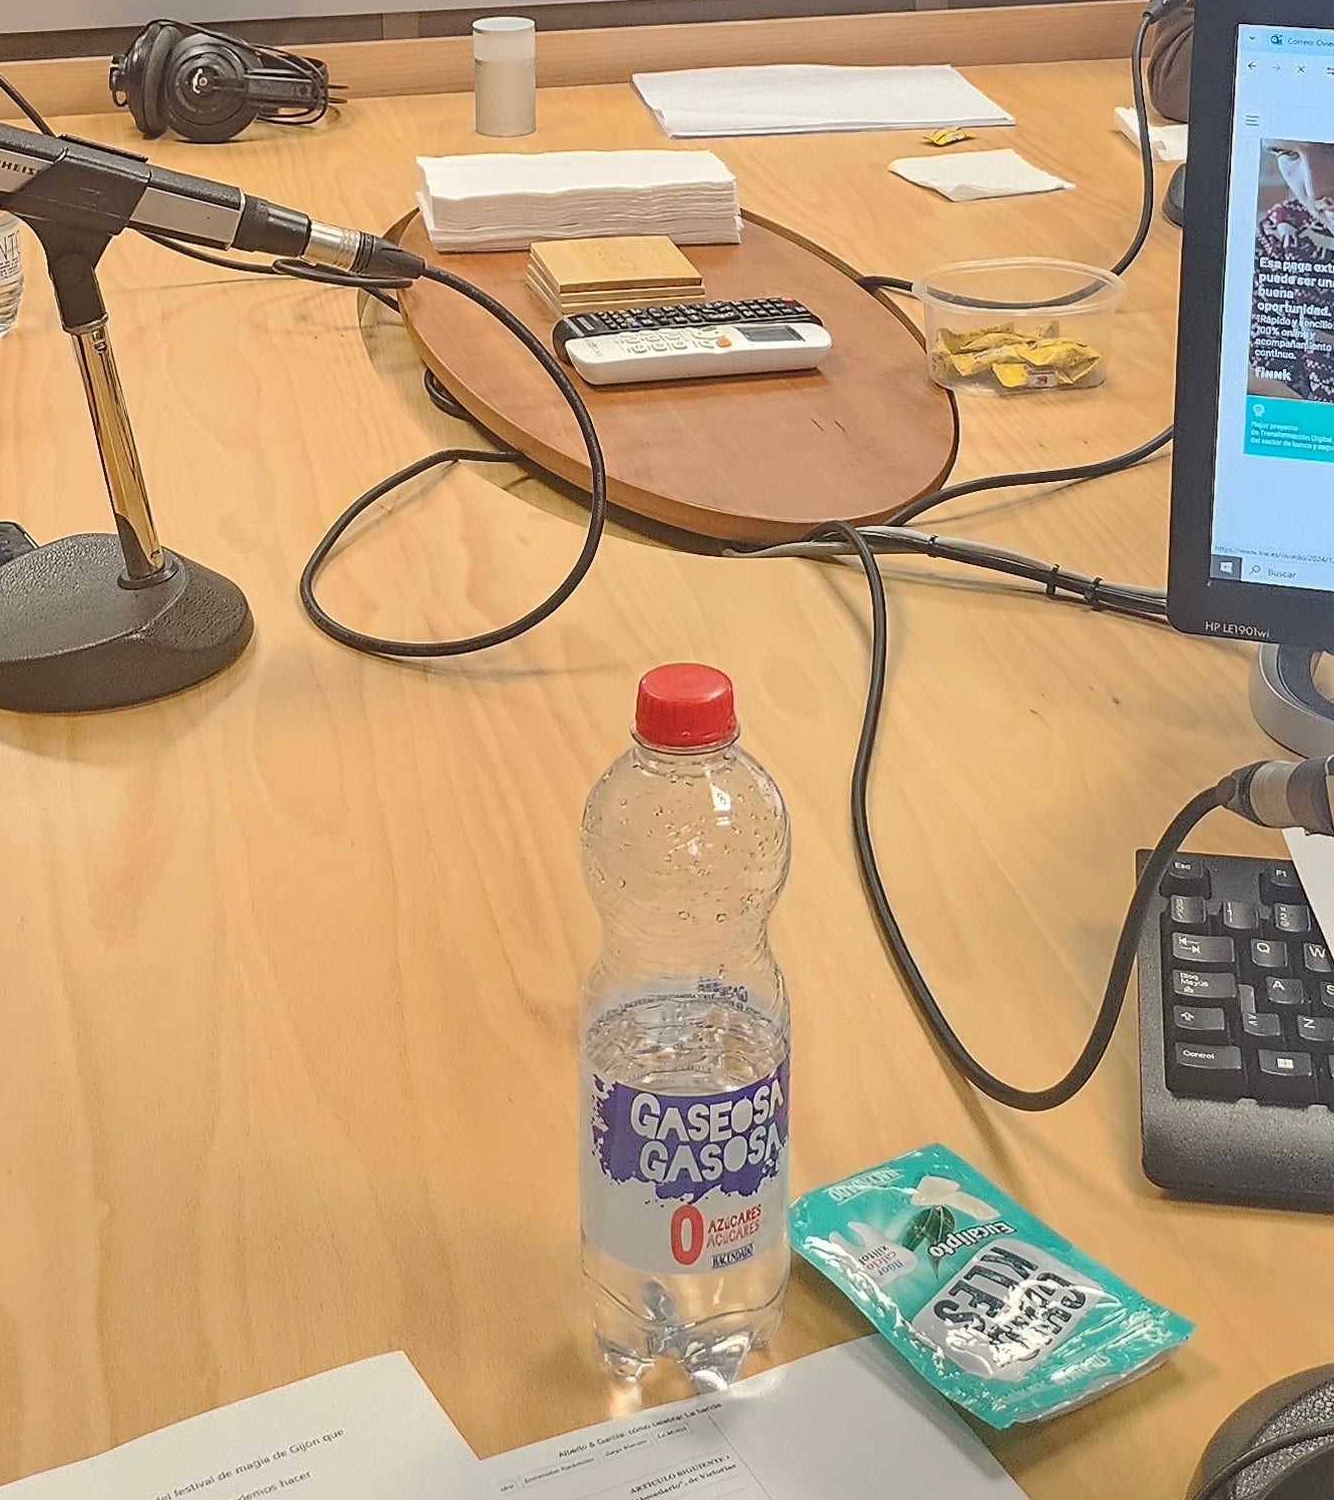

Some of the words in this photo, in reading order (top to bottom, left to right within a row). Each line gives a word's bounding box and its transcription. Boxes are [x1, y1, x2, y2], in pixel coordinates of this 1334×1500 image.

[1205, 621, 1221, 632] HP
[1174, 862, 1191, 871] Esc
[1256, 942, 1271, 953] Q
[1309, 946, 1326, 958] W
[1272, 980, 1285, 990] A
[1183, 1050, 1215, 1061] Control
[630, 1078, 784, 1142] GASEOSA
[639, 1123, 782, 1183] GASOSA
[671, 1204, 705, 1266] 0
[928, 1220, 1017, 1258] Eucalipto
[712, 1242, 754, 1269] HACENDADO
[878, 1258, 906, 1278] flúor
[933, 1246, 1039, 1335] KLES
[173, 1475, 215, 1497] festival
[217, 1471, 232, 1481] de
[235, 1457, 271, 1474] magia
[272, 1450, 288, 1461] de
[289, 1438, 321, 1454] Gijón
[322, 1429, 344, 1443] que
[279, 1471, 311, 1488] hacer
